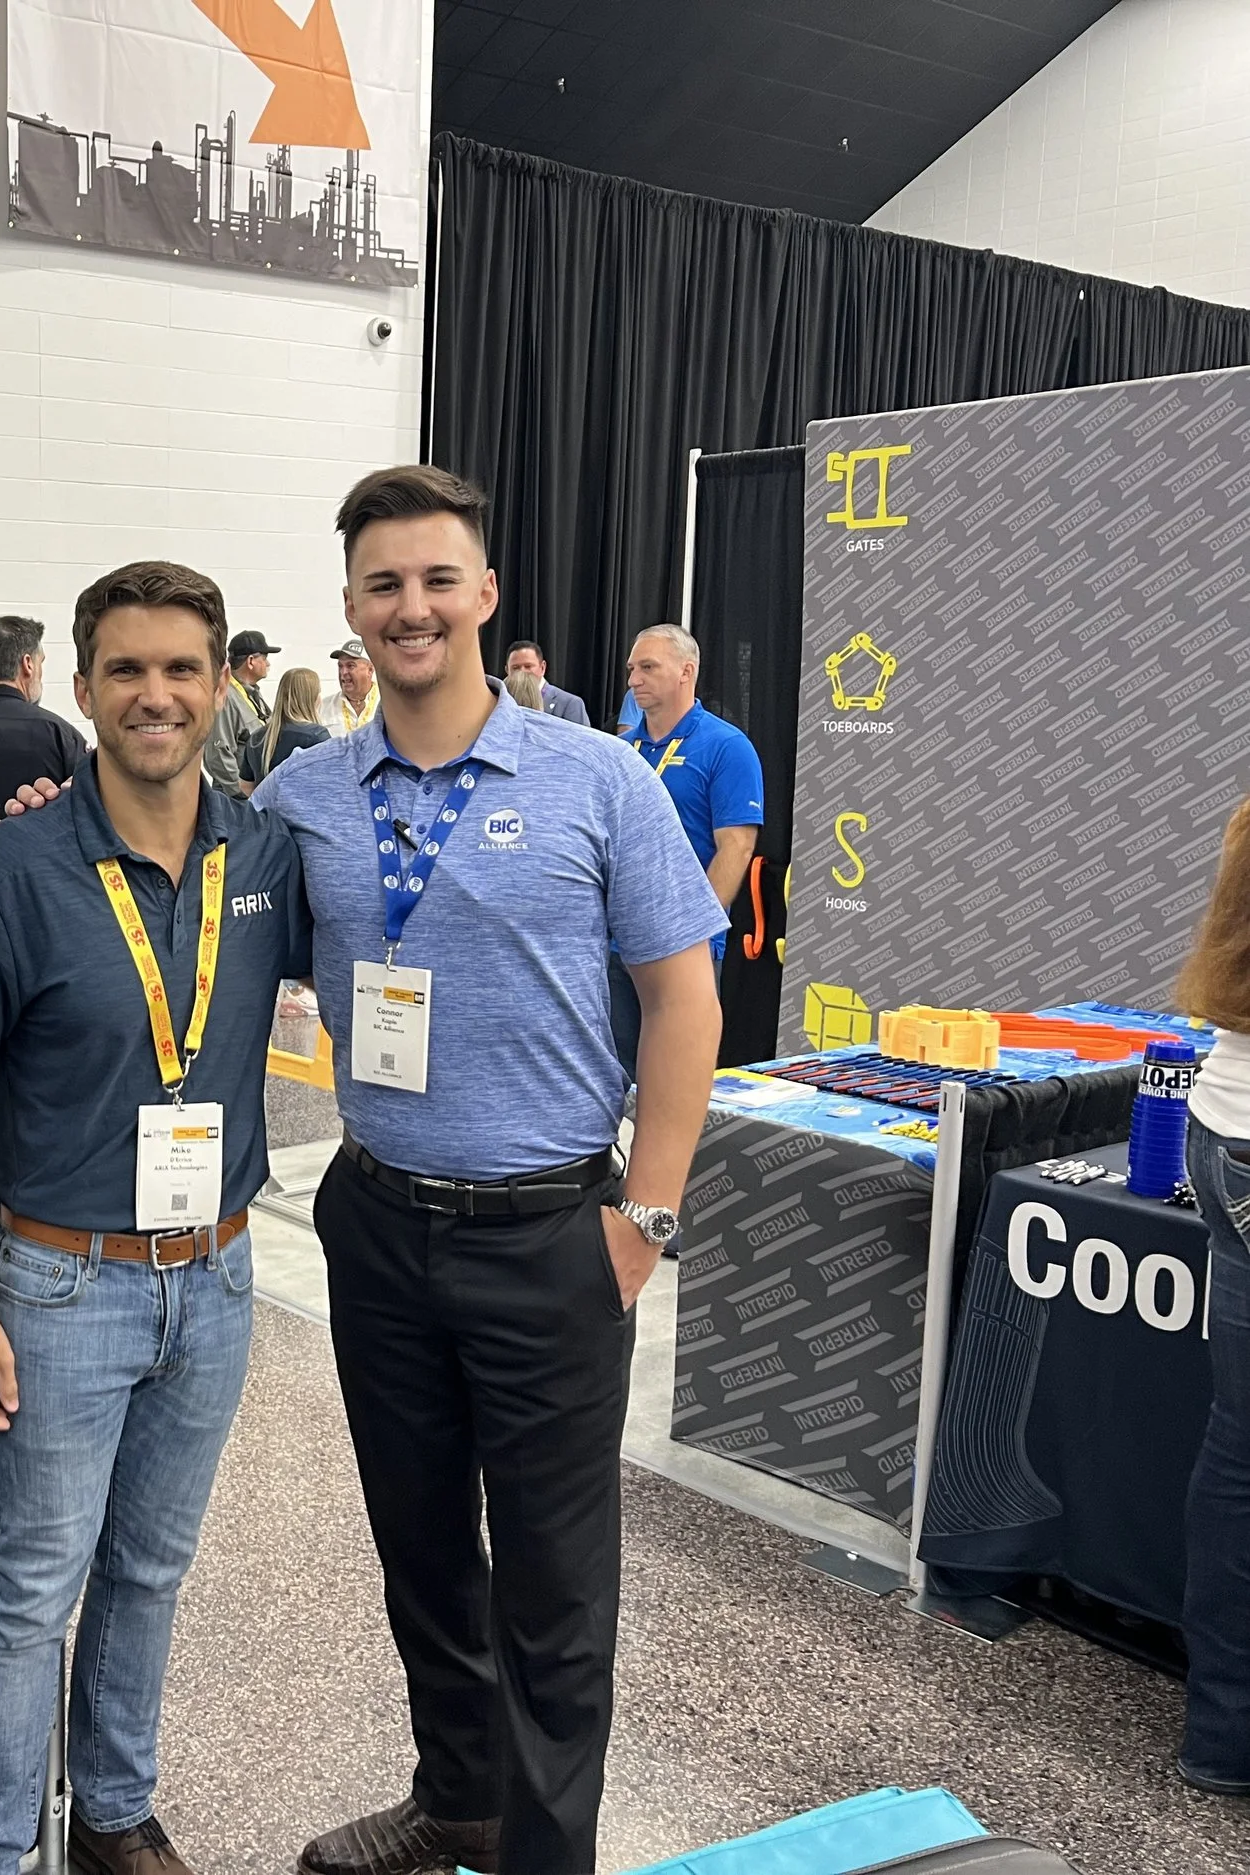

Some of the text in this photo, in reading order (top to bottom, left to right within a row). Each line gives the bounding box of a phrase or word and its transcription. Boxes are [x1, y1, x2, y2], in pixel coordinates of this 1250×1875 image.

[1034, 393, 1078, 432] INTREPID
[1081, 396, 1127, 435] INTREPID
[1132, 396, 1181, 437] INTREPID
[1183, 399, 1235, 440] INTREPID
[931, 440, 972, 476] INTREPID
[976, 442, 1018, 479] INTREPID
[1020, 445, 1064, 483] INTREPID
[1069, 447, 1115, 486] INTREPID
[1117, 451, 1165, 490] INTREPID
[1170, 453, 1220, 493] INTREPID
[921, 488, 961, 523] INTREPID
[963, 492, 1005, 528] INTREPID
[1009, 495, 1053, 532] INTREPID
[1055, 500, 1100, 537] INTREPID
[1105, 503, 1152, 541] INTREPID
[1155, 508, 1204, 547] INTREPID
[846, 538, 884, 553] GATES
[910, 537, 949, 571] INTREPID
[953, 540, 994, 575] INTREPID
[996, 546, 1039, 581] INTREPID
[1043, 550, 1088, 586] INTREPID
[1091, 556, 1137, 592] INTREPID
[1142, 560, 1191, 598] INTREPID
[821, 573, 856, 605] INTREPID
[859, 579, 896, 611] INTREPID
[900, 583, 939, 616] INTREPID
[1193, 567, 1244, 605] INTREPID
[941, 589, 981, 623] INTREPID
[985, 594, 1028, 628] INTREPID
[1030, 601, 1074, 636] INTREPID
[810, 619, 846, 649] INTREPID
[1078, 606, 1125, 641] INTREPID
[1127, 614, 1175, 649] INTREPID
[1180, 619, 1230, 656] INTREPID
[931, 636, 971, 668] INTREPID
[973, 643, 1015, 676] INTREPID
[1019, 649, 1062, 683] INTREPID
[1065, 657, 1110, 691] INTREPID
[1114, 664, 1162, 699] INTREPID
[919, 683, 958, 715] INTREPID
[962, 690, 1003, 722] INTREPID
[1164, 673, 1214, 708] INTREPID
[822, 720, 894, 735] TOEBOARDS
[1006, 699, 1049, 731] INTREPID
[1053, 706, 1098, 739] INTREPID
[909, 729, 948, 759] INTREPID
[1100, 715, 1147, 749] INTREPID
[1151, 723, 1200, 757] INTREPID
[950, 738, 991, 769] INTREPID
[995, 746, 1037, 777] INTREPID
[819, 757, 855, 786] INTREPID
[858, 765, 895, 794] INTREPID
[1040, 756, 1084, 787] INTREPID
[1088, 764, 1134, 797] INTREPID
[898, 775, 936, 804] INTREPID
[940, 783, 980, 813] INTREPID
[1137, 775, 1185, 808] INTREPID
[1190, 785, 1240, 818] INTREPID
[811, 800, 846, 827] INTREPID
[982, 794, 1024, 824] INTREPID
[1028, 803, 1072, 833] INTREPID
[488, 818, 519, 834] BIC
[888, 819, 926, 847] INTREPID
[1074, 814, 1120, 845] INTREPID
[1124, 824, 1172, 856] INTREPID
[478, 842, 528, 850] ALLIANCE
[800, 843, 835, 870] INTREPID
[928, 829, 968, 858] INTREPID
[972, 839, 1013, 868] INTREPID
[877, 863, 914, 891] INTREPID
[1015, 851, 1058, 880] INTREPID
[1062, 861, 1107, 891] INTREPID
[792, 884, 826, 910] INTREPID
[918, 873, 957, 901] INTREPID
[960, 885, 1000, 914] INTREPID
[1110, 874, 1157, 905] INTREPID
[231, 891, 273, 917] ARIX
[825, 897, 868, 912] HOOKS
[868, 906, 905, 932] INTREPID
[1004, 896, 1047, 925] INTREPID
[907, 918, 945, 945] INTREPID
[1049, 910, 1093, 938] INTREPID
[1098, 921, 1144, 951] INTREPID
[820, 937, 855, 962] INTREPID
[949, 930, 989, 957] INTREPID
[992, 943, 1033, 971] INTREPID
[857, 949, 893, 975] INTREPID
[897, 961, 935, 987] INTREPID
[1038, 955, 1081, 983] INTREPID
[937, 975, 977, 1001] INTREPID
[1084, 970, 1129, 998] INTREPID
[376, 1006, 403, 1017] Connor
[753, 1133, 825, 1173] INTREPID
[686, 1174, 735, 1213] INTREPID
[833, 1174, 912, 1206] INTREPID
[747, 1206, 811, 1247] INTREPID
[678, 1247, 729, 1280] INTREPID
[818, 1240, 893, 1282] INTREPID
[1007, 1201, 1213, 1340] Coo
[734, 1283, 797, 1321] INTREPID
[678, 1318, 715, 1342] REPID
[808, 1315, 880, 1357] INTREPID
[720, 1355, 787, 1389] INTREPID
[793, 1395, 865, 1431] INTREPID
